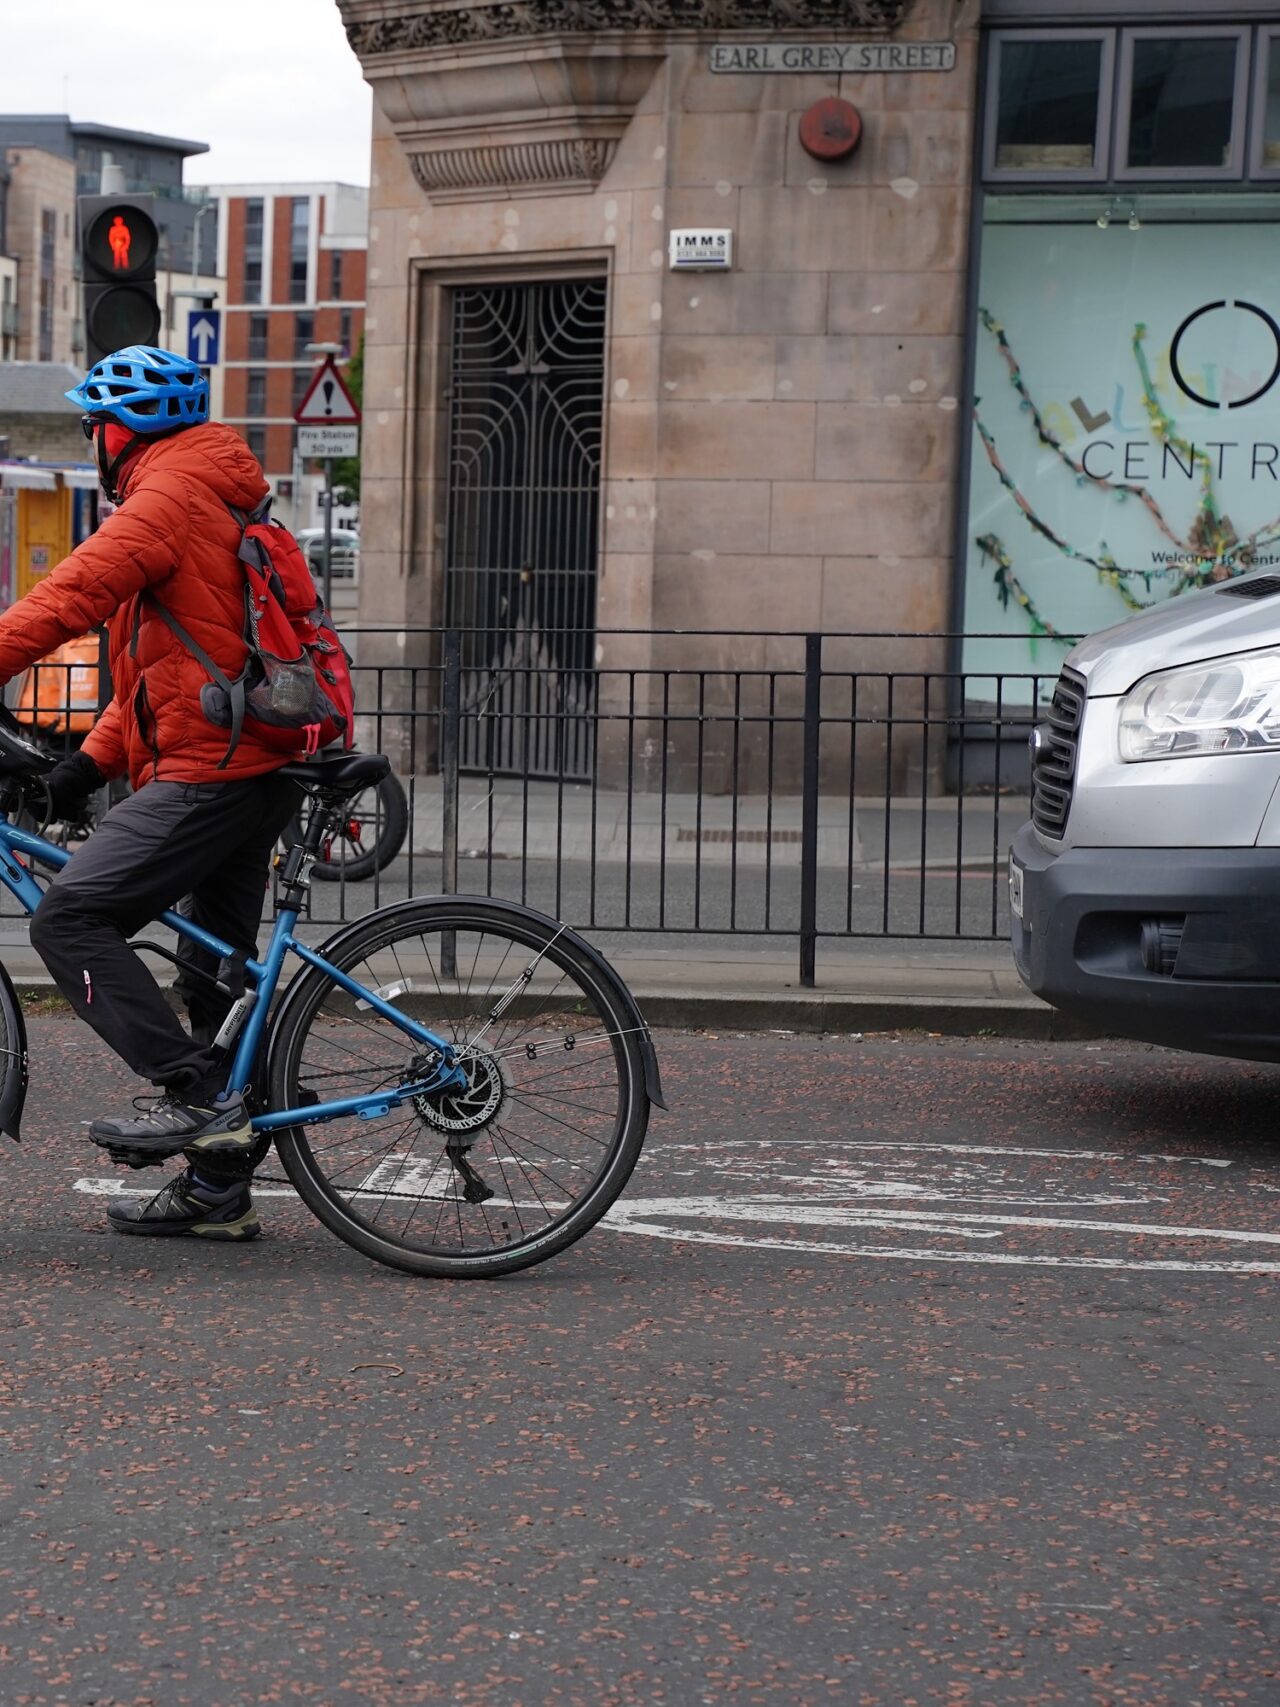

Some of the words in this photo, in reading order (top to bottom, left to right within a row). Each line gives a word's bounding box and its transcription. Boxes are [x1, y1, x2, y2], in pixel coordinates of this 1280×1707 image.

[714, 47, 775, 68] EARL
[782, 46, 851, 68] GREY
[860, 45, 950, 68] STREET
[677, 235, 726, 246] IMMS
[301, 431, 317, 439] Fire
[321, 431, 356, 439] Station
[1151, 551, 1217, 563] Welcome
[1221, 552, 1236, 565] to
[223, 1003, 246, 1036] KRYPTONITE
